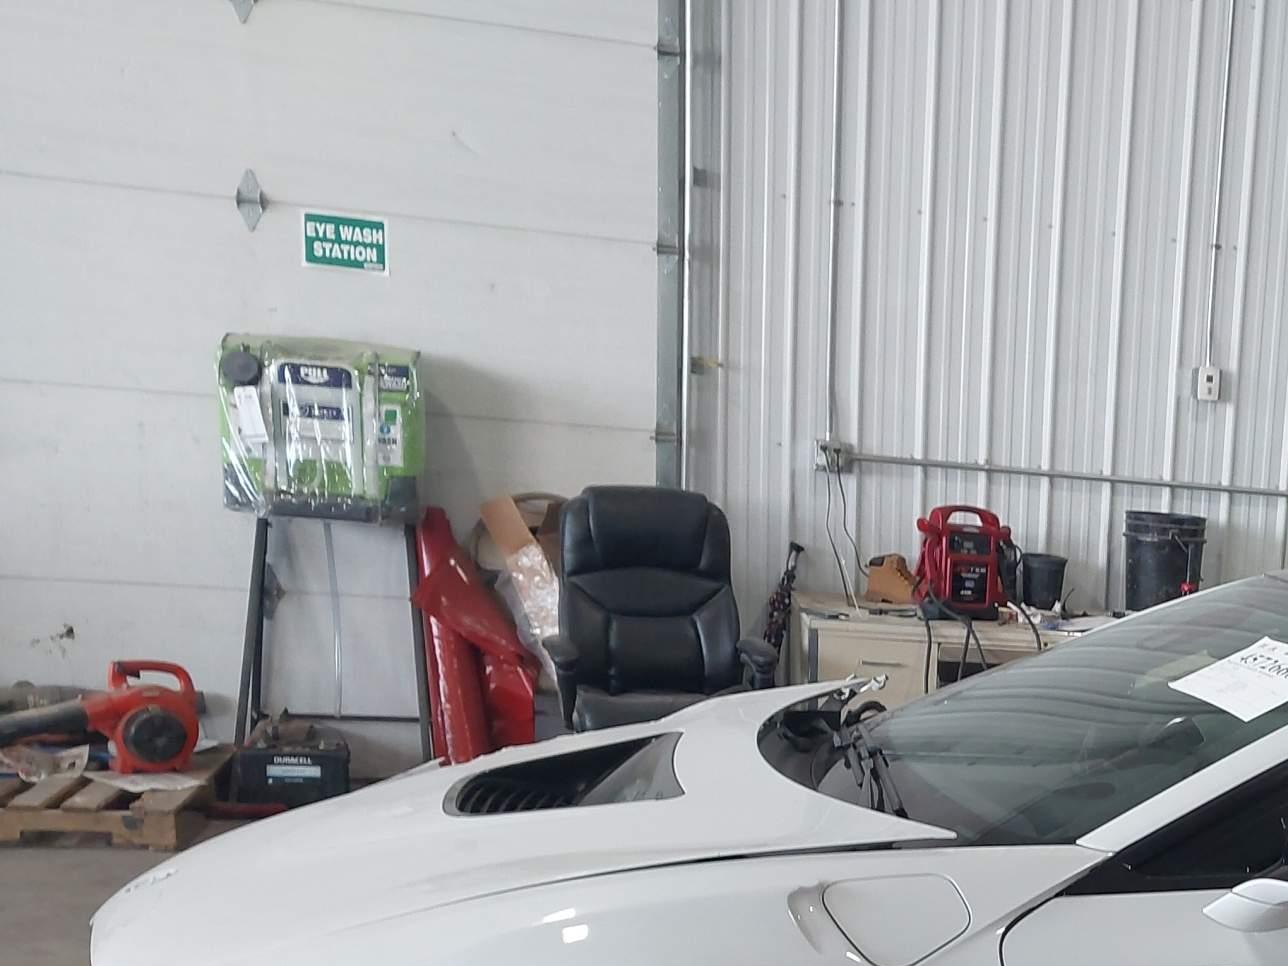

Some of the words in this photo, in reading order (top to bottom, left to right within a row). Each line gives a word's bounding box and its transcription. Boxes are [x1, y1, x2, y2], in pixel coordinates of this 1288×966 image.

[306, 221, 335, 240] EYE
[339, 224, 383, 245] WASH
[313, 240, 377, 262] STATION
[273, 756, 312, 765] DURACELL
